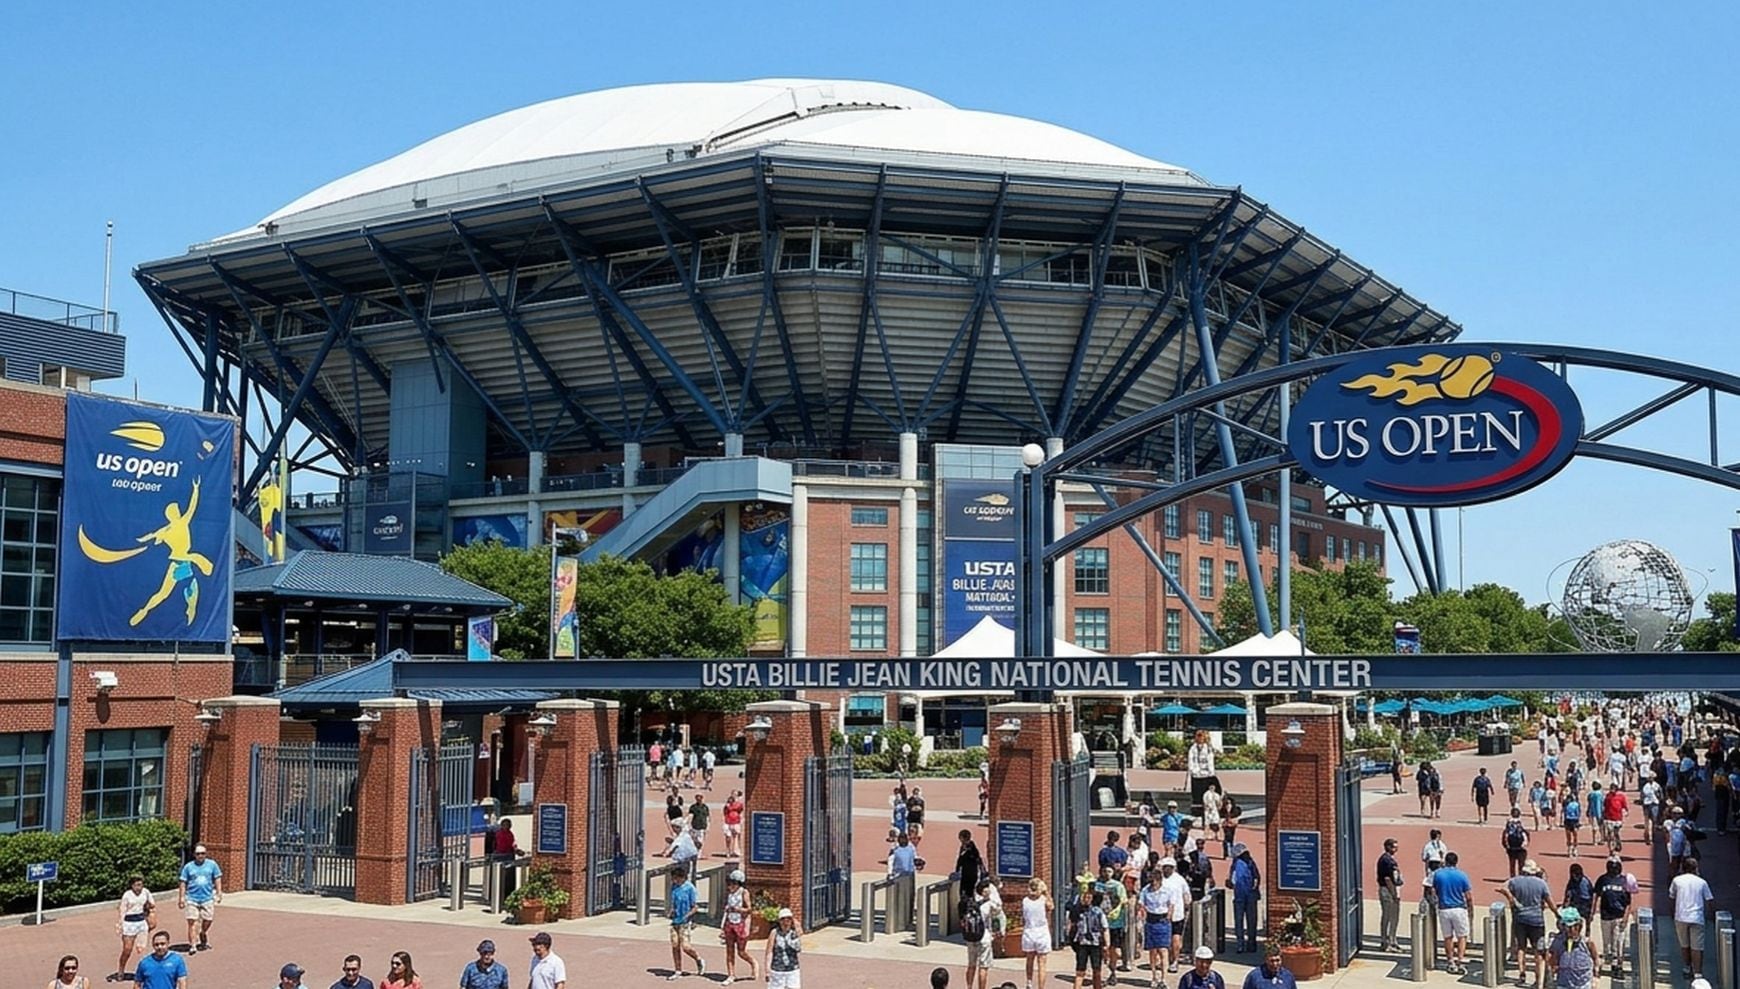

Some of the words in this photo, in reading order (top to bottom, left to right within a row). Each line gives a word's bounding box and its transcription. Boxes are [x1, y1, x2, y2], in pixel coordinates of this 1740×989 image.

[1309, 418, 1370, 460] US
[1382, 410, 1524, 457] OPEN
[96, 452, 123, 471] us
[124, 457, 180, 479] open
[964, 561, 1015, 576] USTA
[702, 662, 762, 688] USTA
[768, 662, 840, 687] BILLIE
[847, 661, 911, 687] JEAN
[920, 661, 982, 687] KING
[991, 661, 1129, 687] NATIONAL
[1135, 660, 1242, 687] TENNIS
[1251, 660, 1372, 687] CENTER
